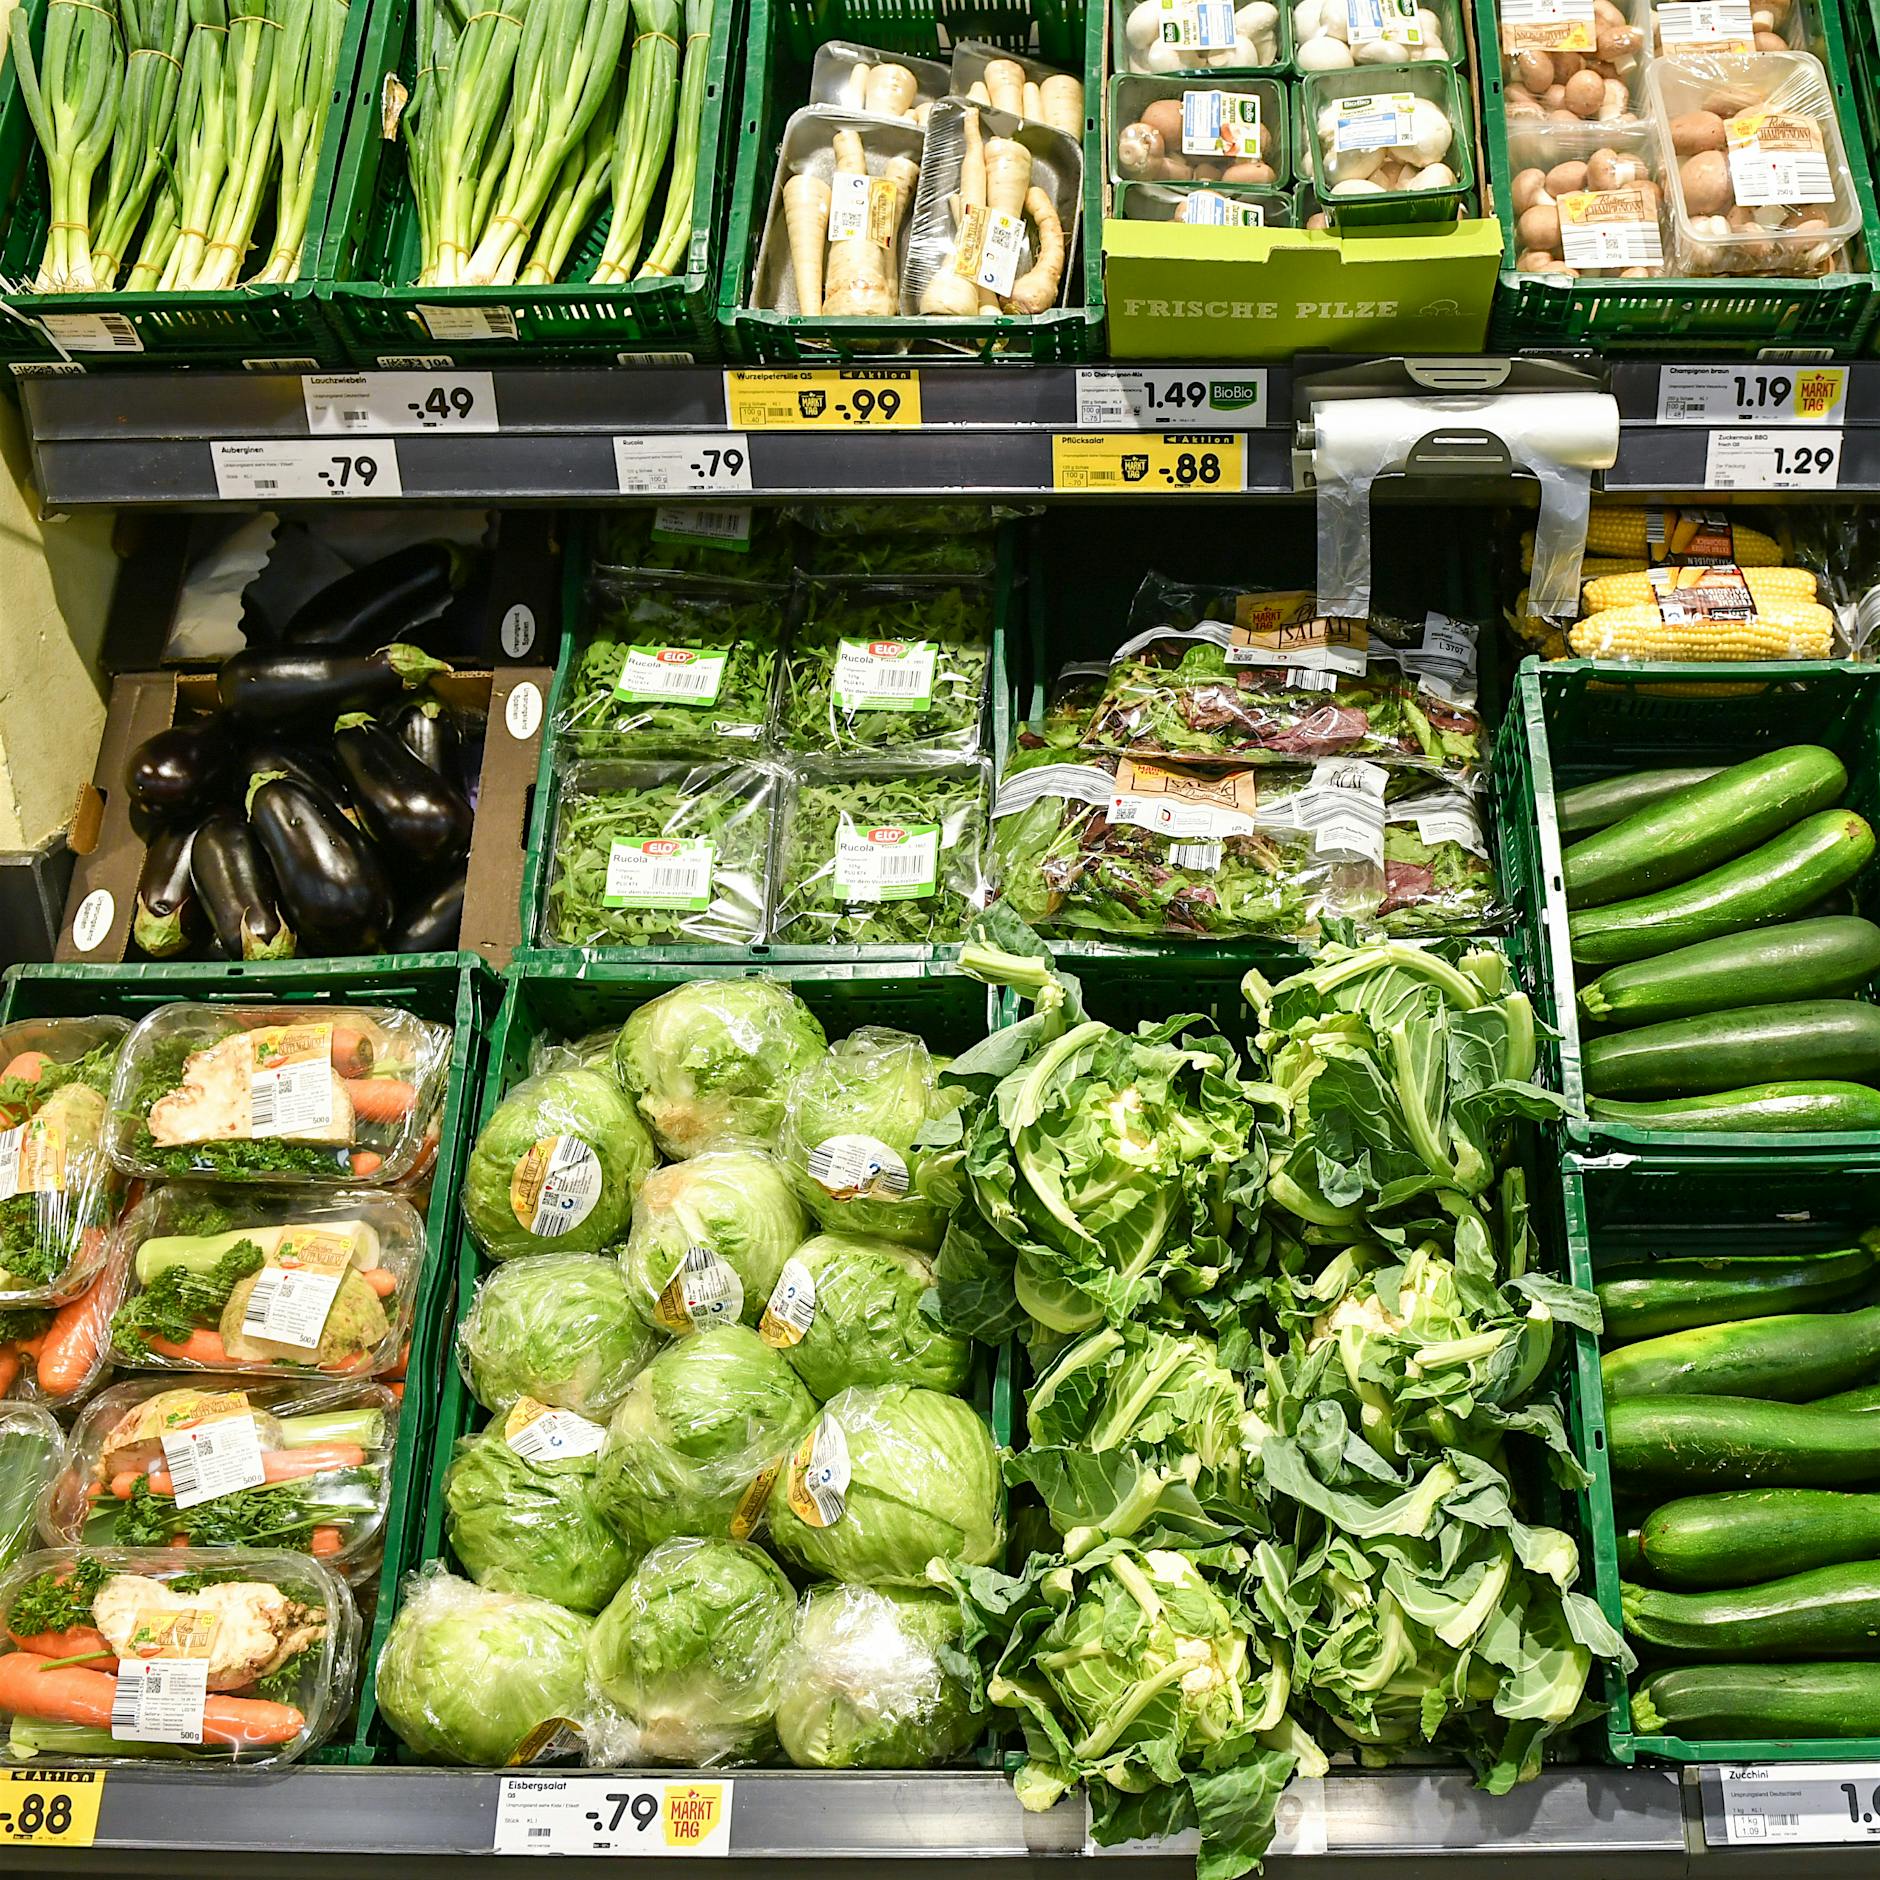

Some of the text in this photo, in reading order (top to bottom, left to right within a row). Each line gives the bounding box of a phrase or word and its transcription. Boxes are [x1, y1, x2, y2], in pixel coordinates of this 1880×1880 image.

[1124, 299, 1398, 319] FRISCHE PILZE
[311, 376, 367, 385] Lauchzwiebeln
[737, 373, 798, 381] Wurzelpetersilie
[1144, 382, 1207, 409] 1.49
[1213, 386, 1254, 399] BioBio
[1734, 377, 1792, 407] 1.19
[1801, 383, 1836, 398] MARKT
[408, 387, 474, 419] -.49
[801, 397, 823, 407] MARKT
[835, 389, 901, 421] -.99
[1802, 399, 1824, 411] TAG
[804, 407, 819, 416] TAG
[221, 447, 264, 455] Auberginen
[691, 449, 744, 477] -.79
[1124, 461, 1146, 471] MARKT
[1774, 448, 1834, 474] 1.29
[318, 456, 378, 487] -.79
[1159, 453, 1221, 484] -.88
[1127, 470, 1140, 479] TAG
[1253, 611, 1281, 623] MARKT
[1256, 622, 1273, 630] TAG
[875, 645, 897, 654] ELO
[664, 652, 687, 662] ELO
[842, 654, 874, 664] Rucola
[628, 658, 661, 668] Rucola
[875, 831, 899, 841] ELO
[649, 843, 673, 853] ELO
[840, 843, 874, 852] Rucola
[613, 855, 648, 863] Rucola
[300, 1335, 312, 1344] 500
[243, 1475, 257, 1485] 500
[33, 1772, 90, 1782] Aktion
[1729, 1770, 1769, 1780] Zucchini
[509, 1781, 567, 1792] Eisbergsalat
[0, 1794, 72, 1834] -.88
[586, 1793, 658, 1832] -.79
[671, 1801, 714, 1821] MARKT
[1748, 1817, 1758, 1825] kg
[674, 1821, 700, 1839] TAG
